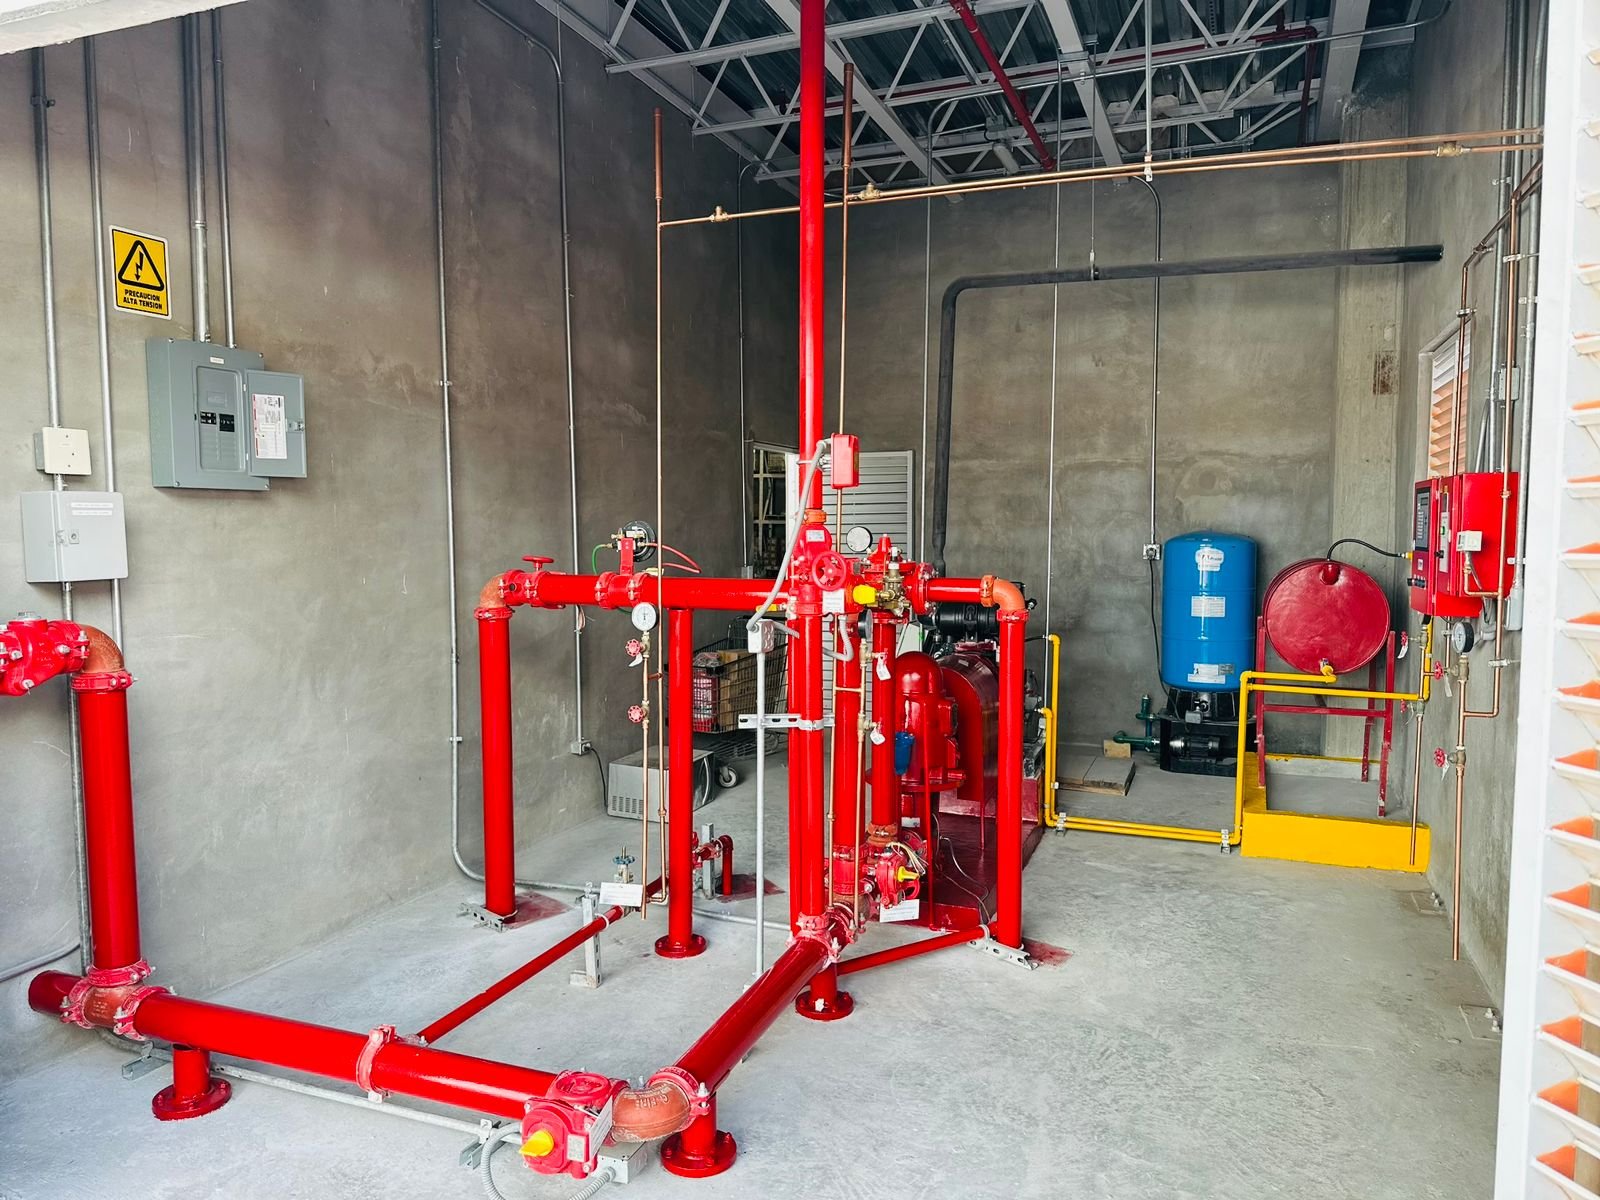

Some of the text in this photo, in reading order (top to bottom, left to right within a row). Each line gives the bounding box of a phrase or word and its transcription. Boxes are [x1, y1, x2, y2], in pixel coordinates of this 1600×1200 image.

[124, 289, 160, 302] PRECAUCION
[123, 297, 163, 310] ALTA TENSION
